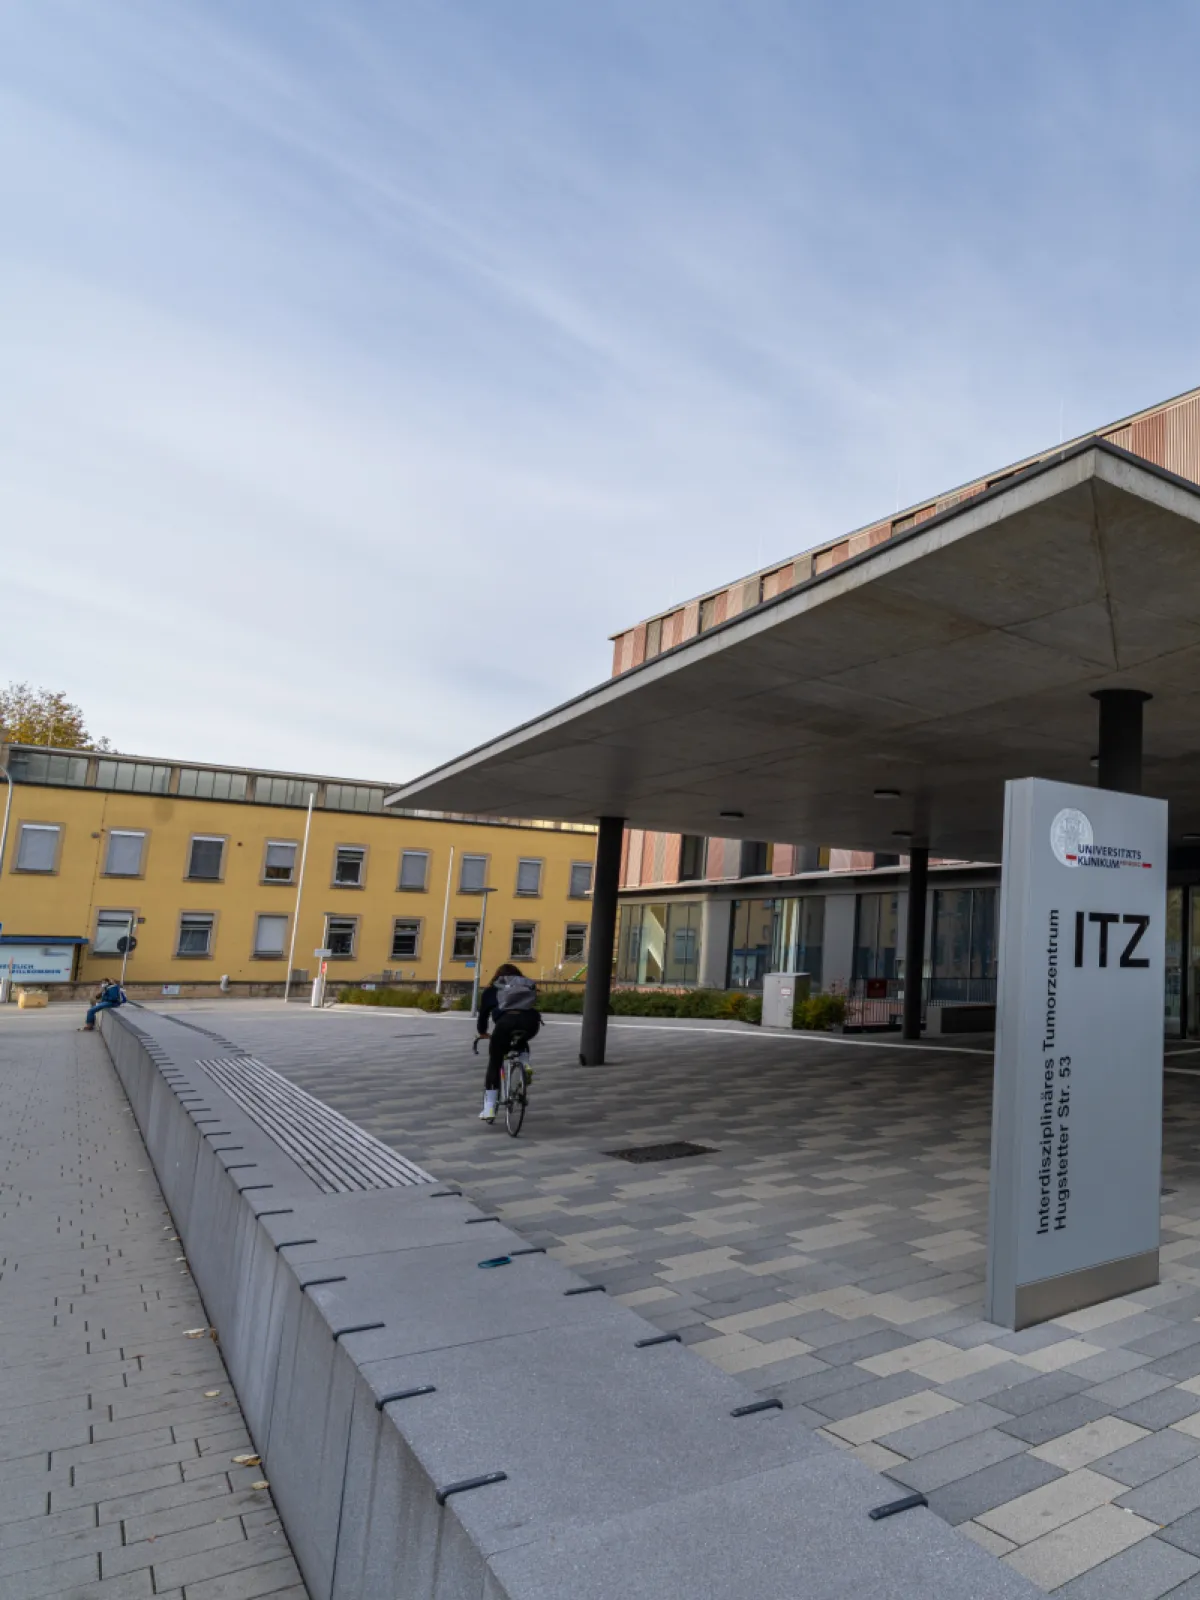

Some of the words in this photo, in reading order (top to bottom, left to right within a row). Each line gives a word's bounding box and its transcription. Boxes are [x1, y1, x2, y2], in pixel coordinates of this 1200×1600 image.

[1077, 843, 1142, 860] UNIVERSITÄTS
[1077, 855, 1121, 869] KLINIKUM
[1074, 911, 1151, 968] ITZ
[1042, 909, 1060, 1052] Tumorzentrum
[1059, 1055, 1072, 1079] 53
[1057, 1084, 1071, 1119] Str.
[1036, 1058, 1055, 1236] Interdisziplinäres
[1054, 1124, 1071, 1231] Hugstetter
